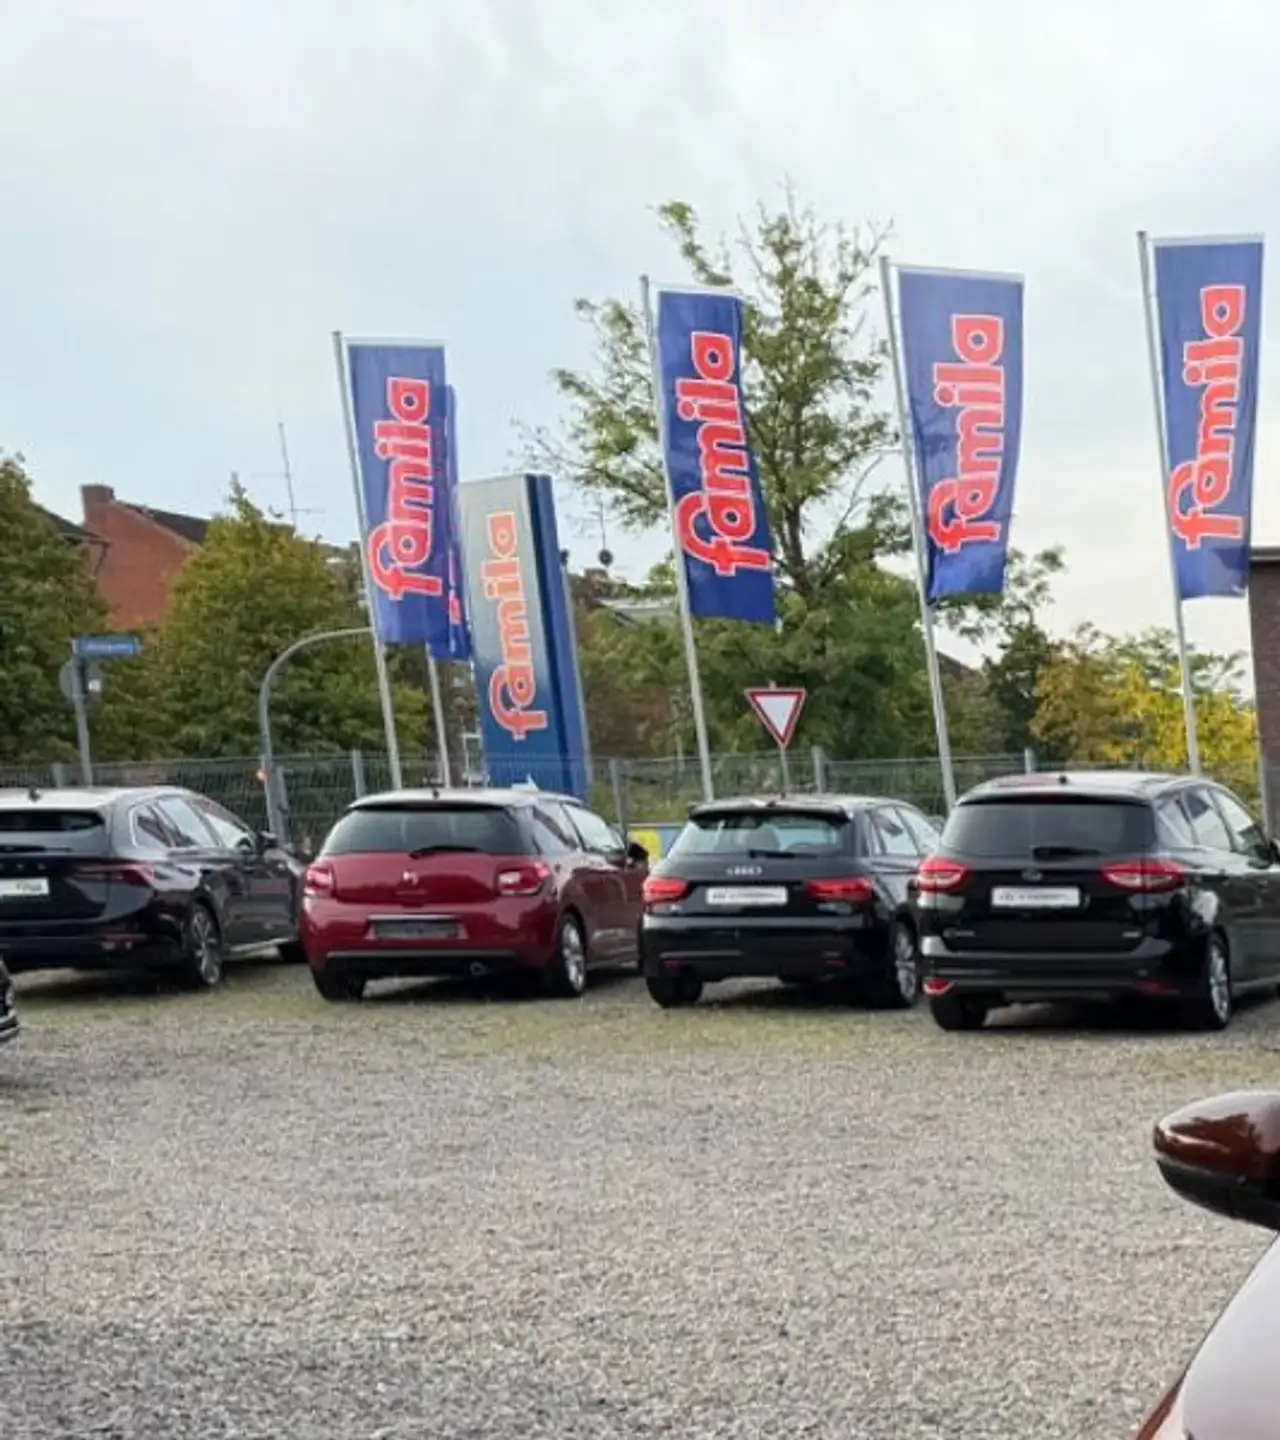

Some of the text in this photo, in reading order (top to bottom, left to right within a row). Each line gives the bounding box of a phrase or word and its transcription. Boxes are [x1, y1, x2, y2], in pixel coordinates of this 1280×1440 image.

[367, 377, 442, 600] famila
[676, 331, 771, 577] famila
[929, 314, 1005, 553] famila
[1167, 284, 1246, 550] famila
[482, 510, 548, 741] famila
